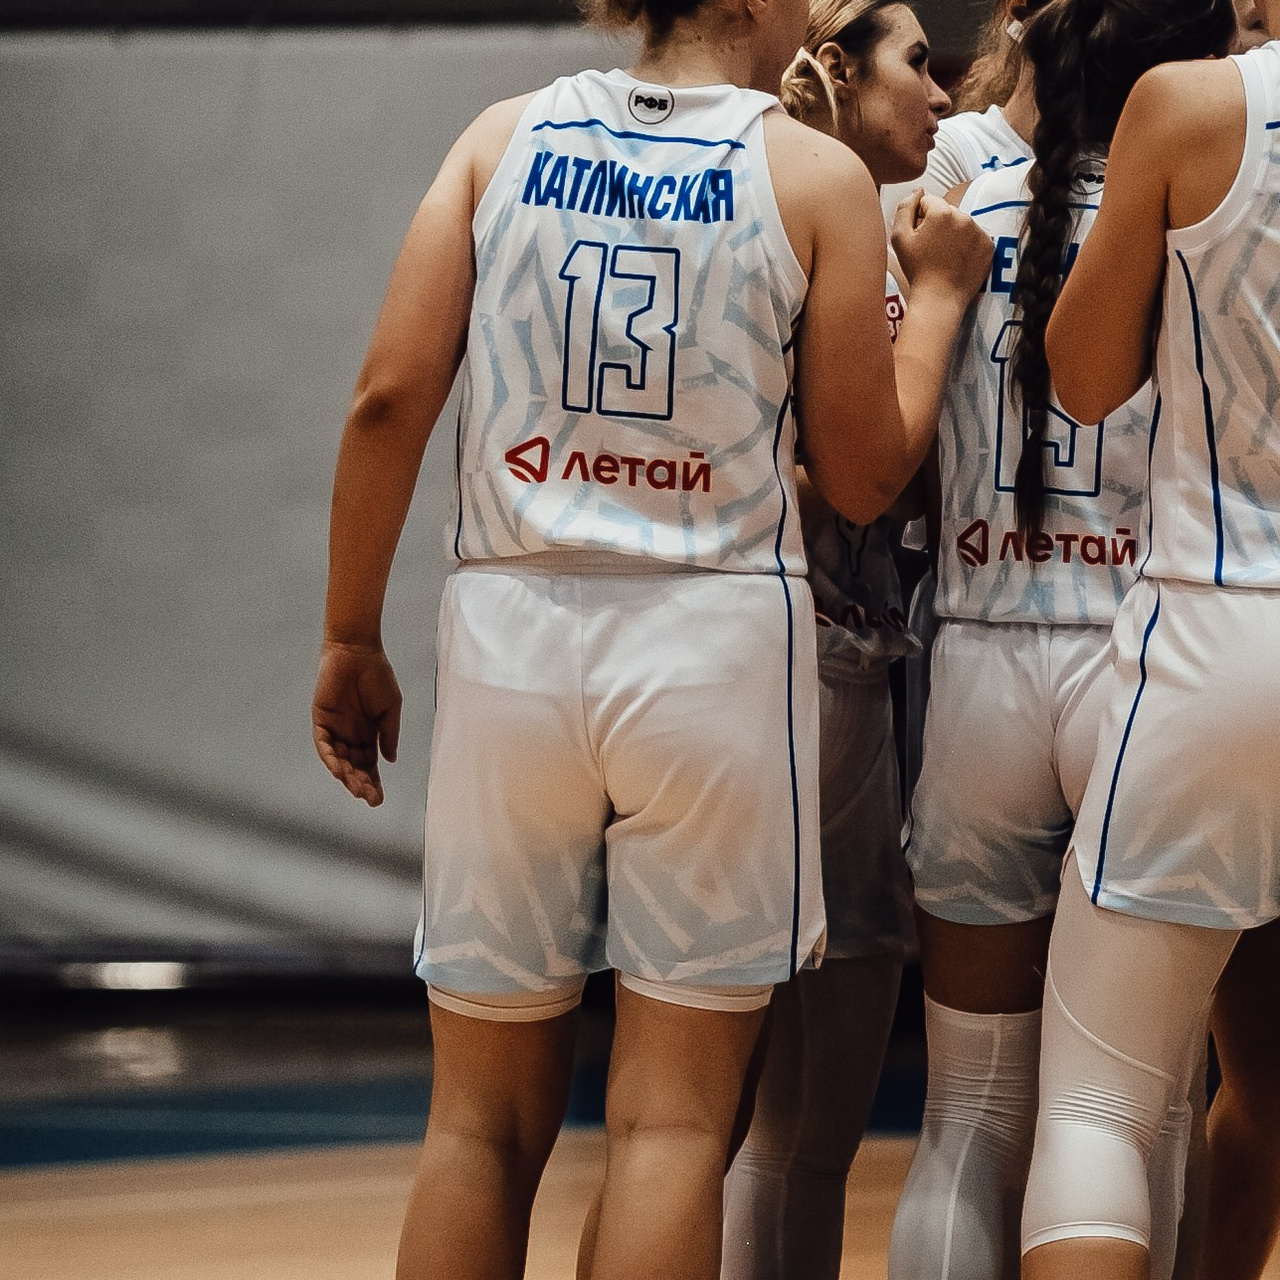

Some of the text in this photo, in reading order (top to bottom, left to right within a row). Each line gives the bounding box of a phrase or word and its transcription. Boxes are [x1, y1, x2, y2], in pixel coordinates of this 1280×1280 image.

[634, 94, 669, 111] РФБ
[521, 150, 734, 223] КАТЛИНСКАЯ
[558, 239, 681, 421] 13
[561, 452, 712, 493] летай
